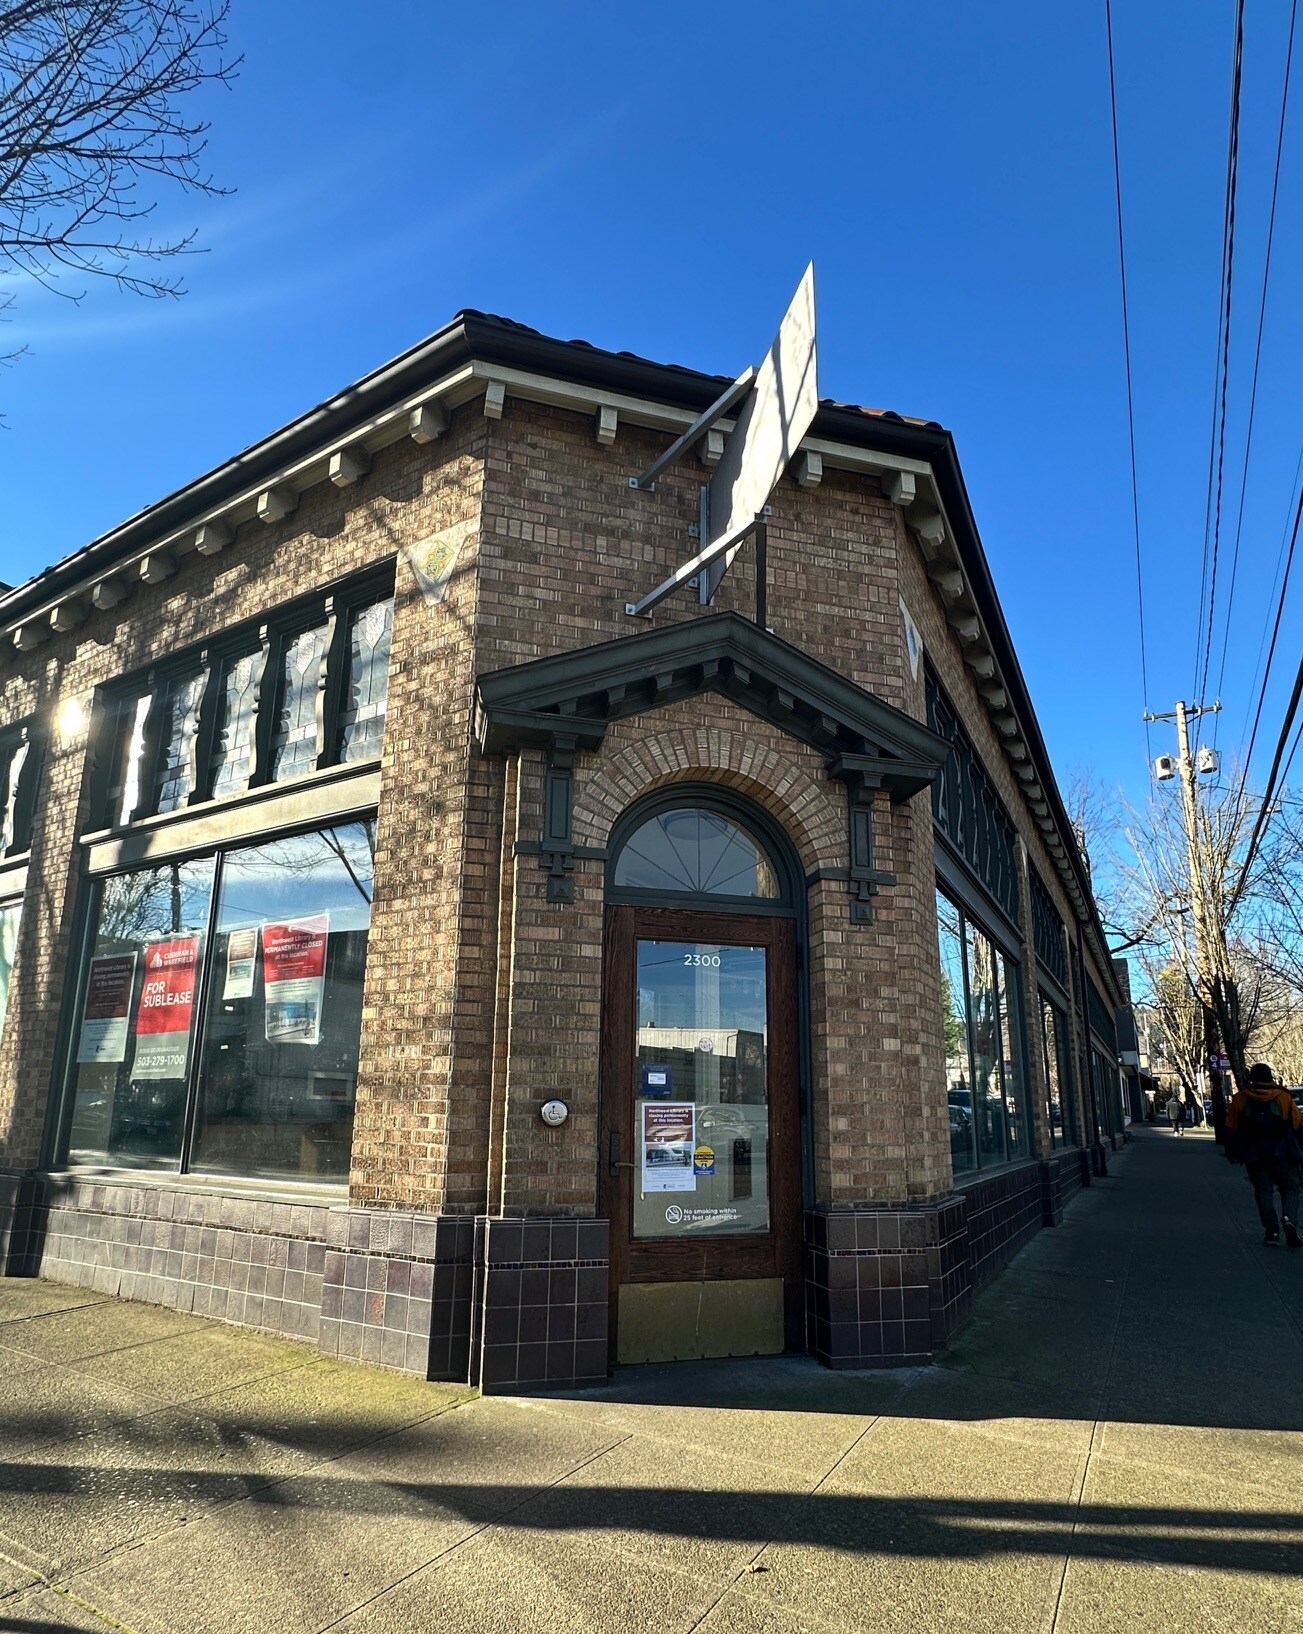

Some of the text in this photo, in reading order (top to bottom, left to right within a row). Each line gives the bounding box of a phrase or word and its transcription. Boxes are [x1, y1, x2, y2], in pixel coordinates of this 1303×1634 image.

[272, 936, 294, 945] Northwest
[264, 940, 323, 954] PERMANENTLY CLOSED
[163, 950, 189, 960] CUSHMAN
[163, 956, 194, 966] WAKEFIELD
[684, 954, 721, 967] 2300
[146, 981, 166, 995] FOR
[143, 990, 191, 1008] SUBLEASE
[136, 1054, 184, 1066] 503-279-1700
